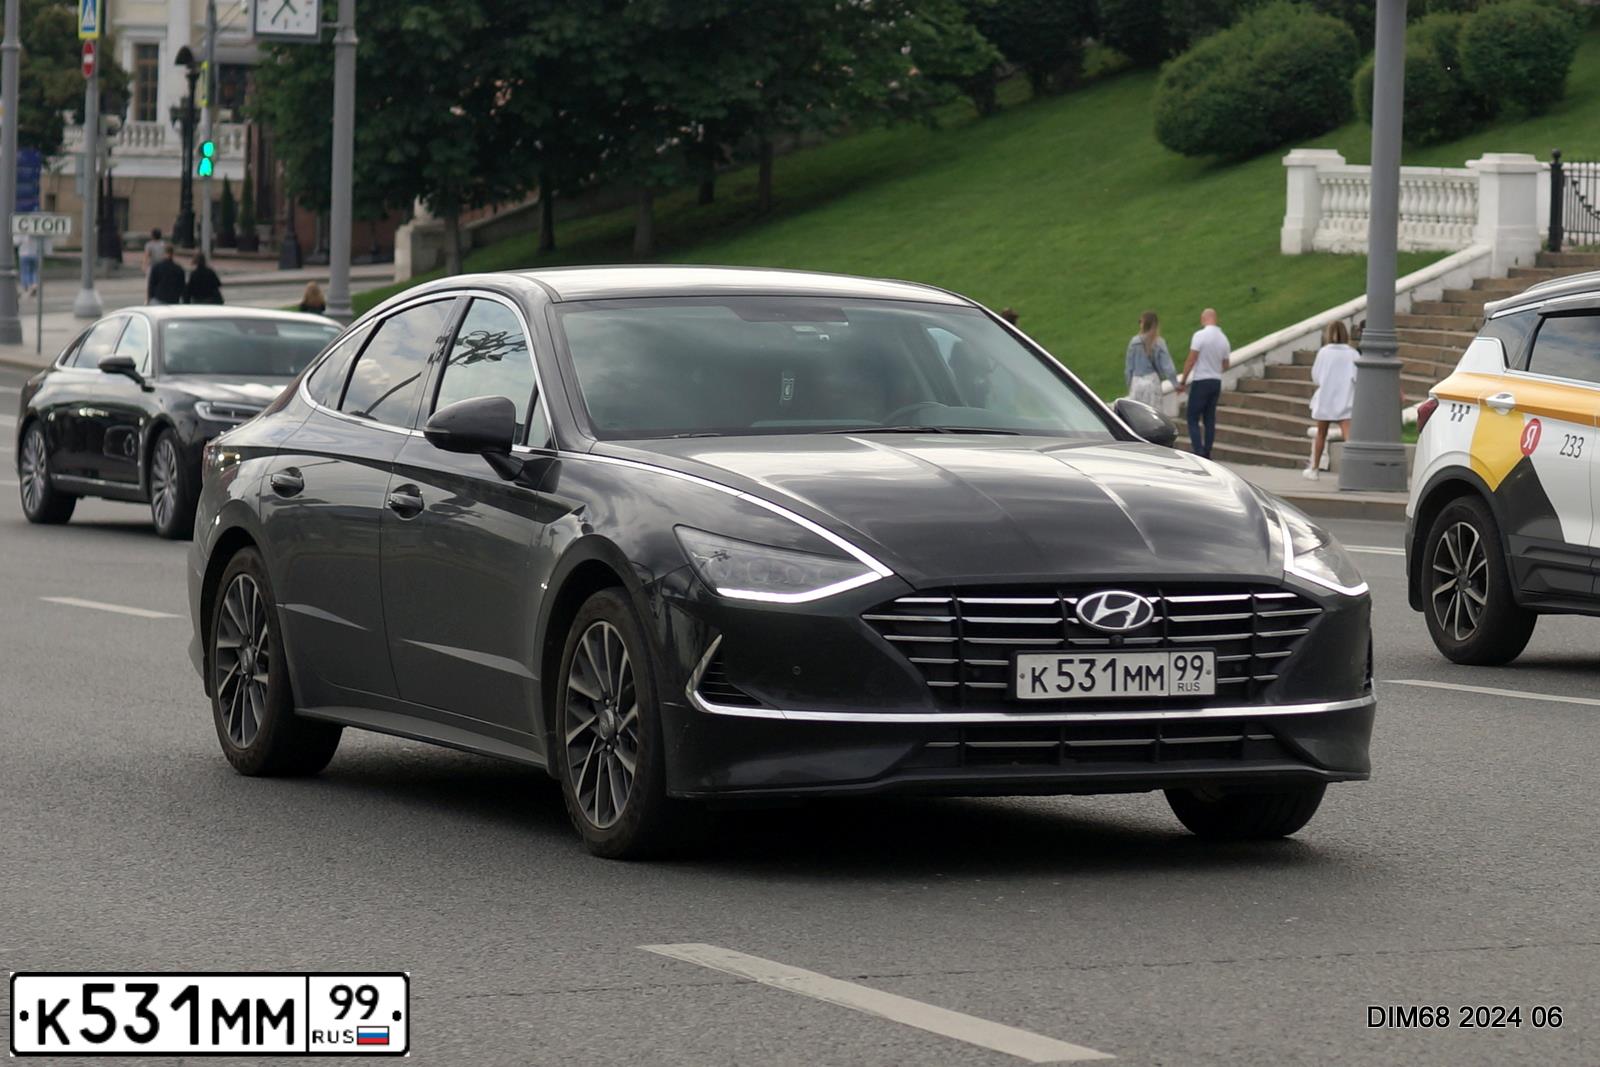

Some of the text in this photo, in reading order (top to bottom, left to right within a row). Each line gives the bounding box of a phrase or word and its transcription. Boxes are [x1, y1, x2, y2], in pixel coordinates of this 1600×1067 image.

[17, 217, 66, 232] СТОП
[1523, 425, 1538, 450] Я
[1559, 433, 1585, 458] 233
[1173, 655, 1204, 681] 99
[1177, 681, 1201, 692] RUS
